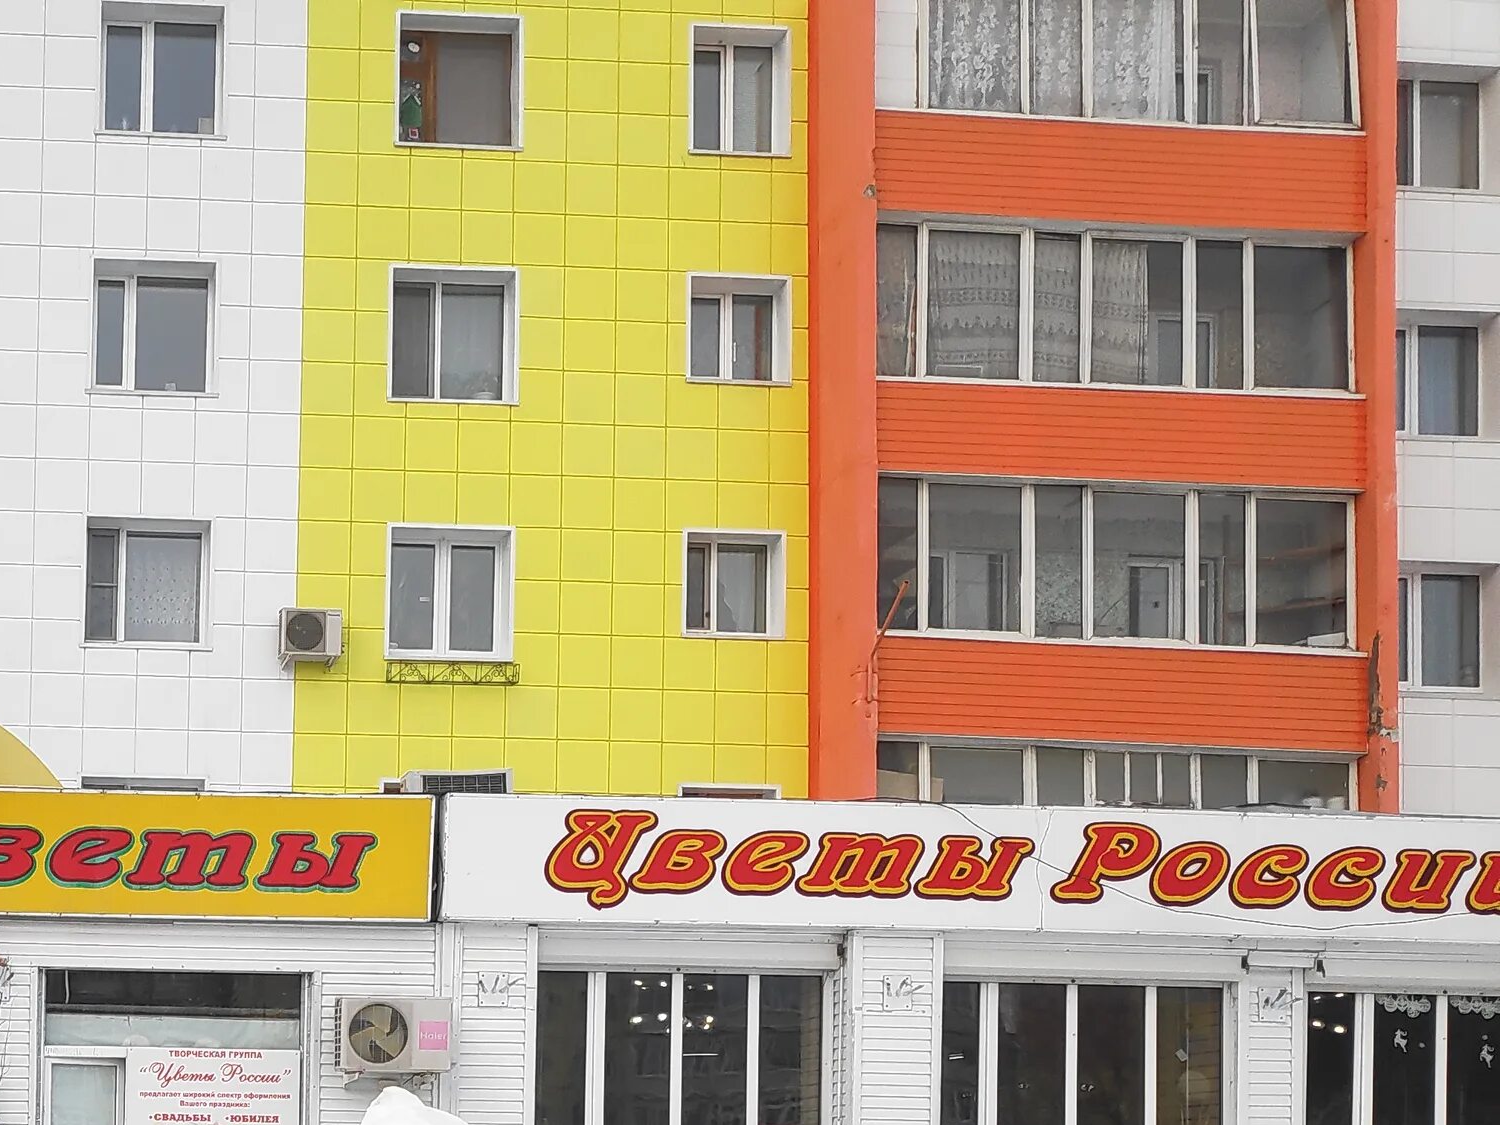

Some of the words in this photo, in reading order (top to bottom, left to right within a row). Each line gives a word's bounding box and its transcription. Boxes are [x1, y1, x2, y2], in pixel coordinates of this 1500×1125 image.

[544, 809, 1035, 911] Цветы
[420, 1031, 448, 1040] Haier
[169, 1050, 226, 1058] ТВОРЧЕСКАЯ
[228, 1051, 263, 1059] ГРУППА
[154, 1114, 211, 1122] СВАДЬБЫ
[230, 1115, 279, 1123] ЮБИЛЕЯ
